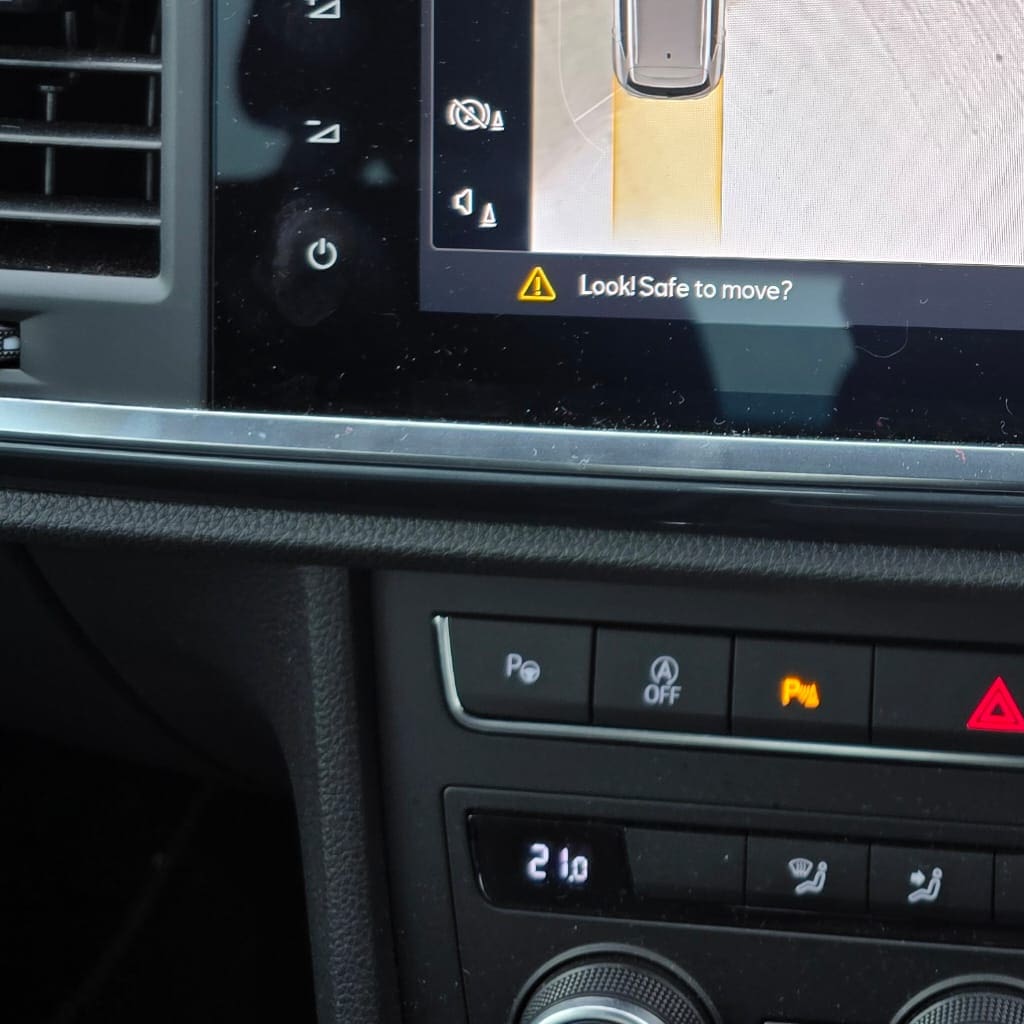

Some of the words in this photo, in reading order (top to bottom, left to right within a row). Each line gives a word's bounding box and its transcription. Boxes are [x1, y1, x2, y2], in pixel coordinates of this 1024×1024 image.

[578, 273, 637, 296] Look!
[639, 276, 690, 298] Safe
[694, 279, 717, 298] to
[722, 280, 793, 301] move?
[643, 684, 682, 705] OFF
